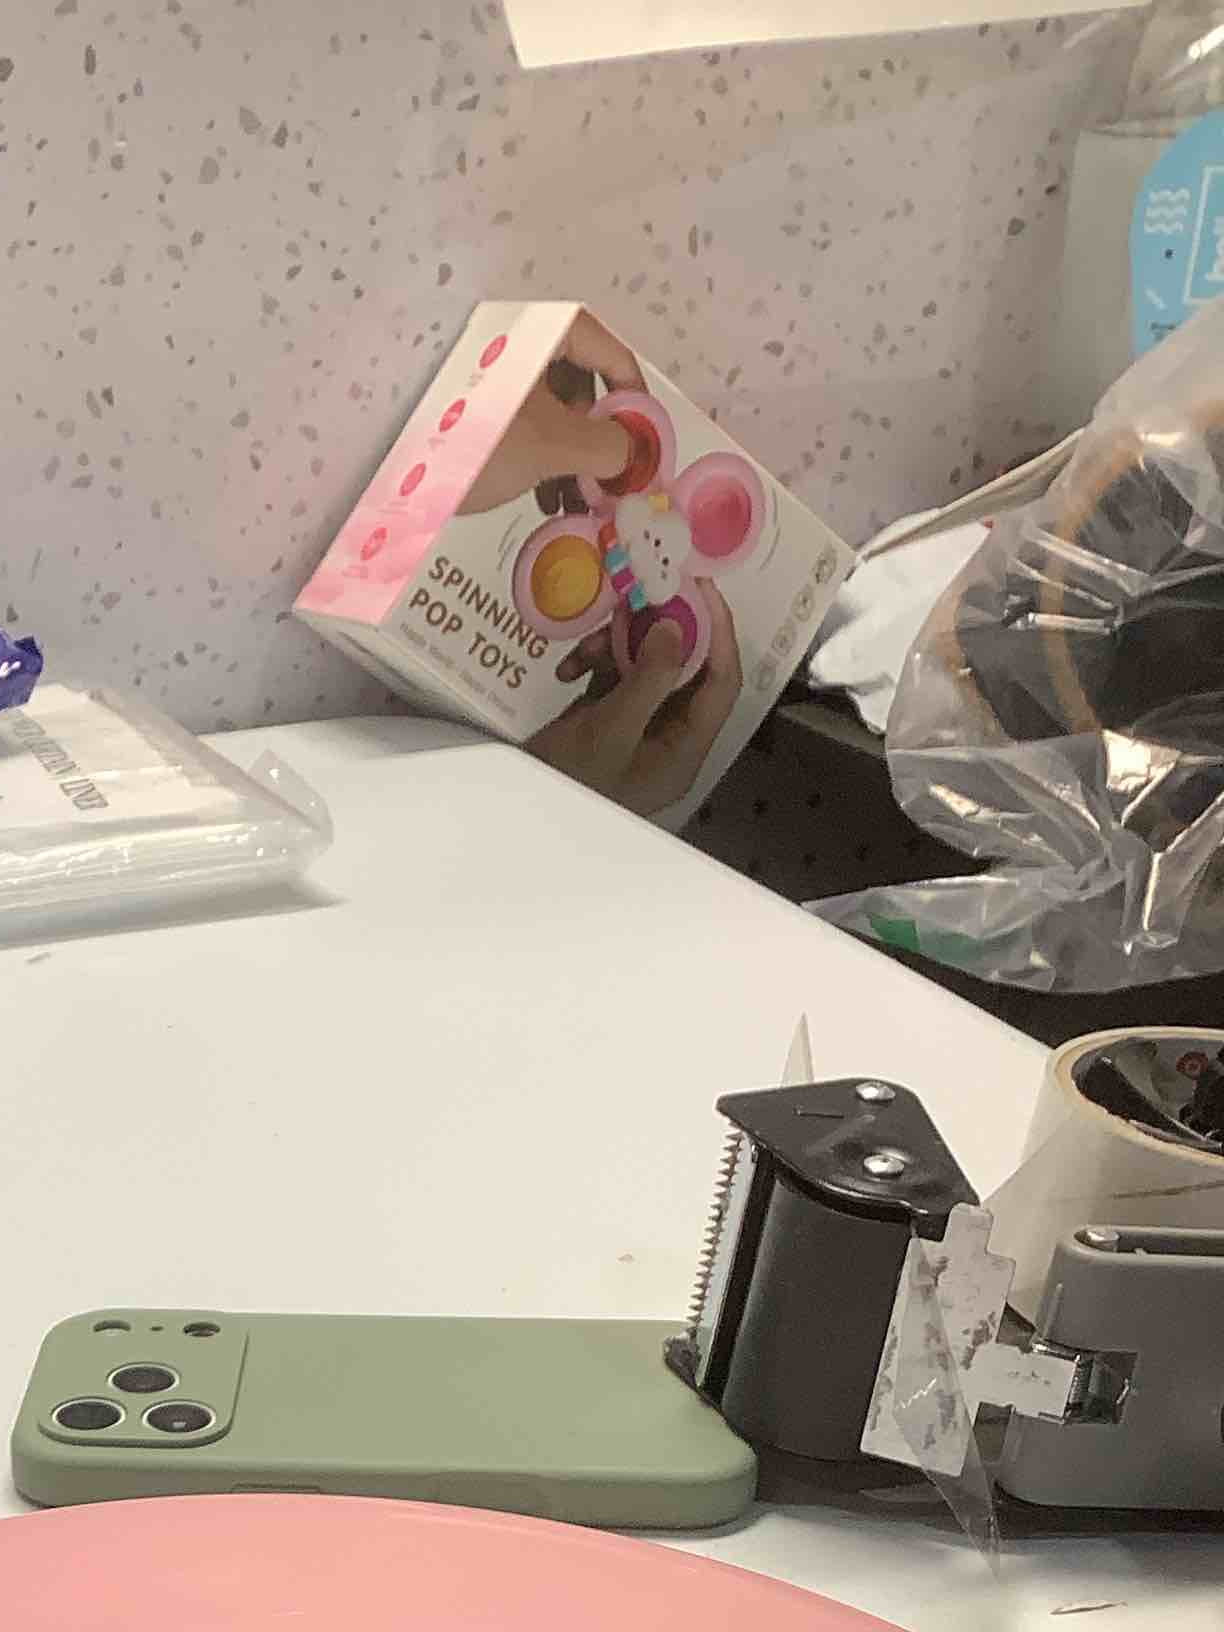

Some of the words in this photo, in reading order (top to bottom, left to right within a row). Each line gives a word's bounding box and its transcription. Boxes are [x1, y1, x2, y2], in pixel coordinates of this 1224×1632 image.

[408, 587, 464, 636] POP
[467, 631, 528, 689] TOYS
[428, 555, 550, 660] SPINNING
